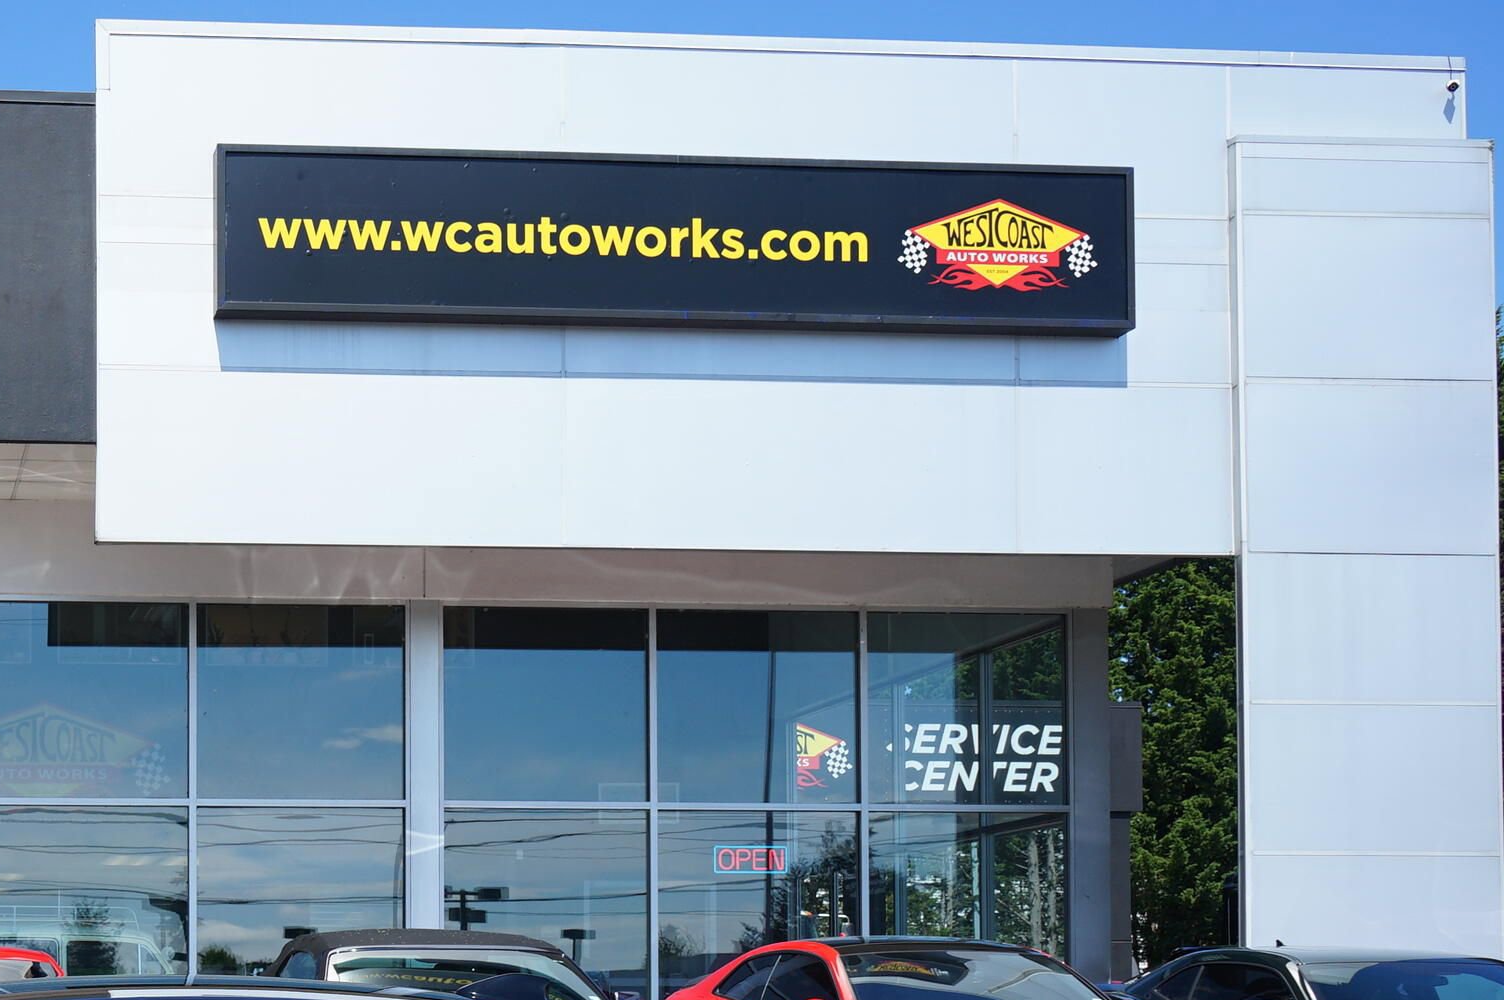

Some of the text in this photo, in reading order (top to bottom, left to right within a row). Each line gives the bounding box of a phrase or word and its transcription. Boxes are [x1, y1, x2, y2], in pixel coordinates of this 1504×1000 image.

[258, 217, 868, 262] www.wcautoworks.com
[946, 252, 1049, 264] AUTO WORKS
[38, 768, 108, 782] WORKS
[718, 848, 785, 870] OPEN
